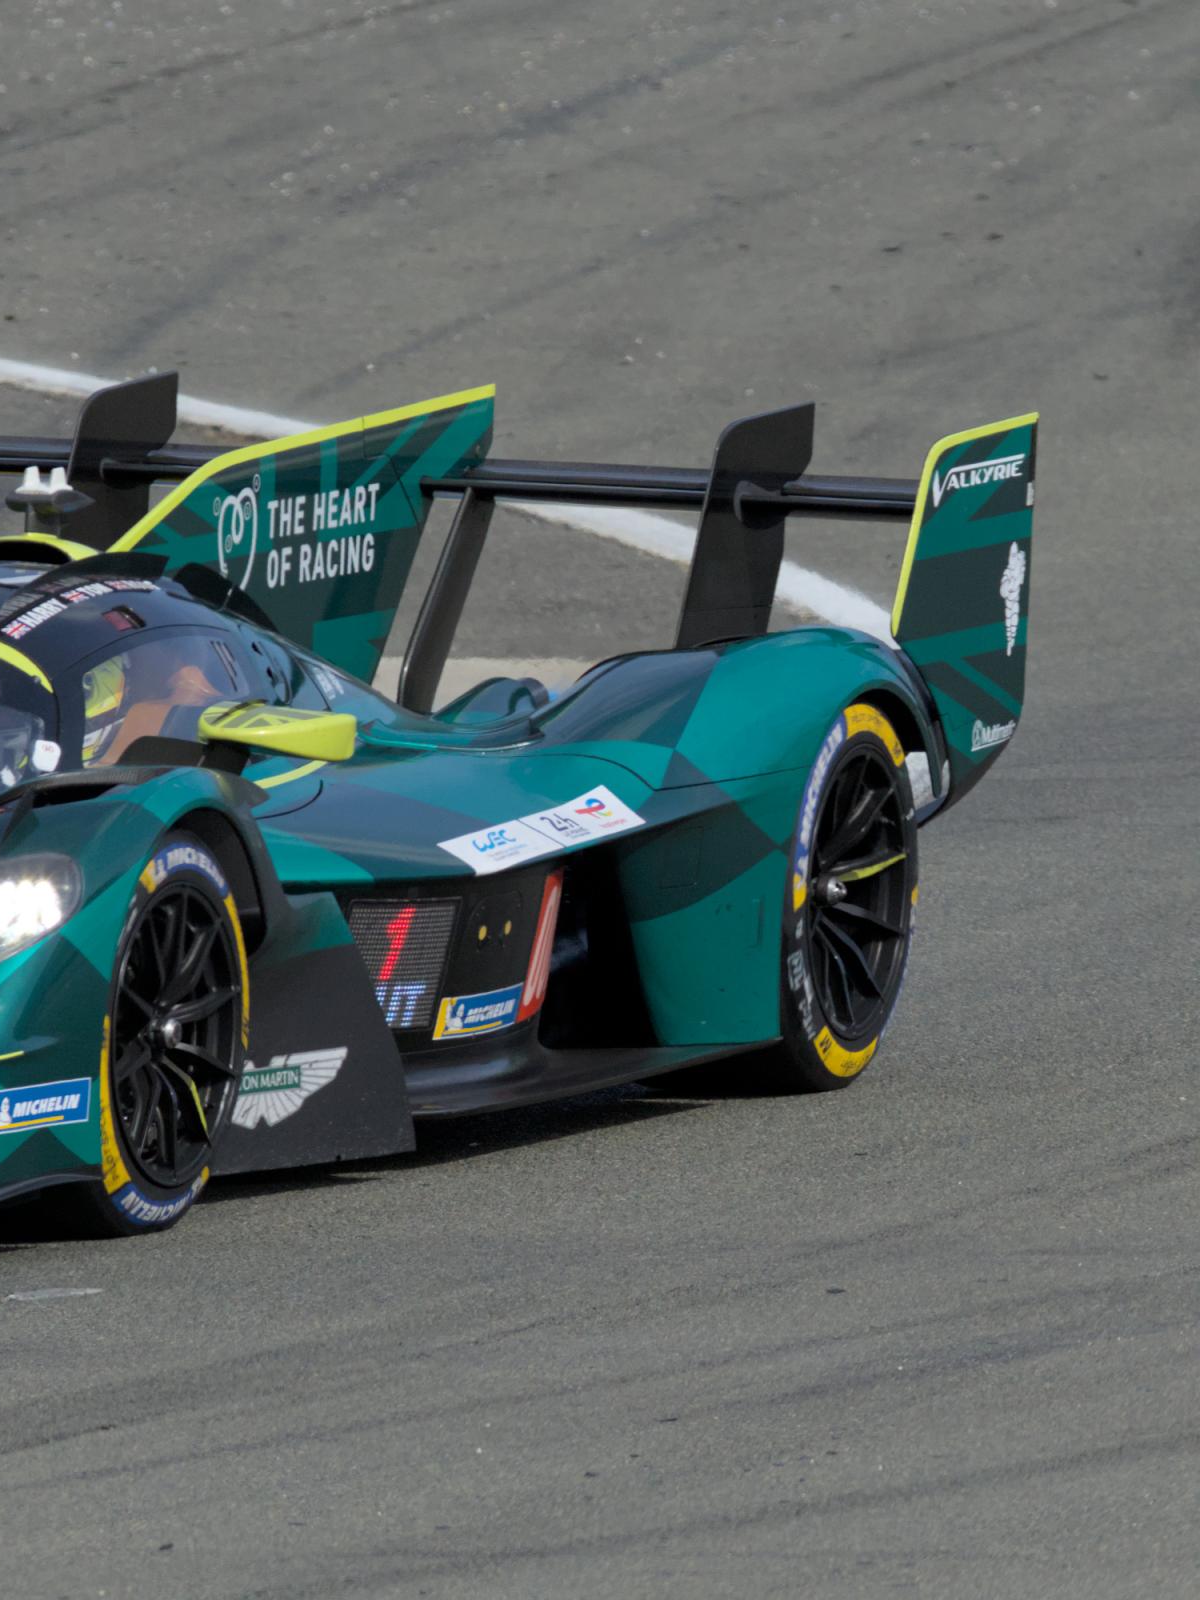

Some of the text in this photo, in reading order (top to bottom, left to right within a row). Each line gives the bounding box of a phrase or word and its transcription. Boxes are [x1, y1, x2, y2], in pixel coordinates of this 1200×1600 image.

[932, 453, 1025, 508] VALKYRIE
[266, 483, 380, 540] THE HEART
[266, 533, 375, 588] OF RACING
[12, 1093, 81, 1119] MICHELIN
